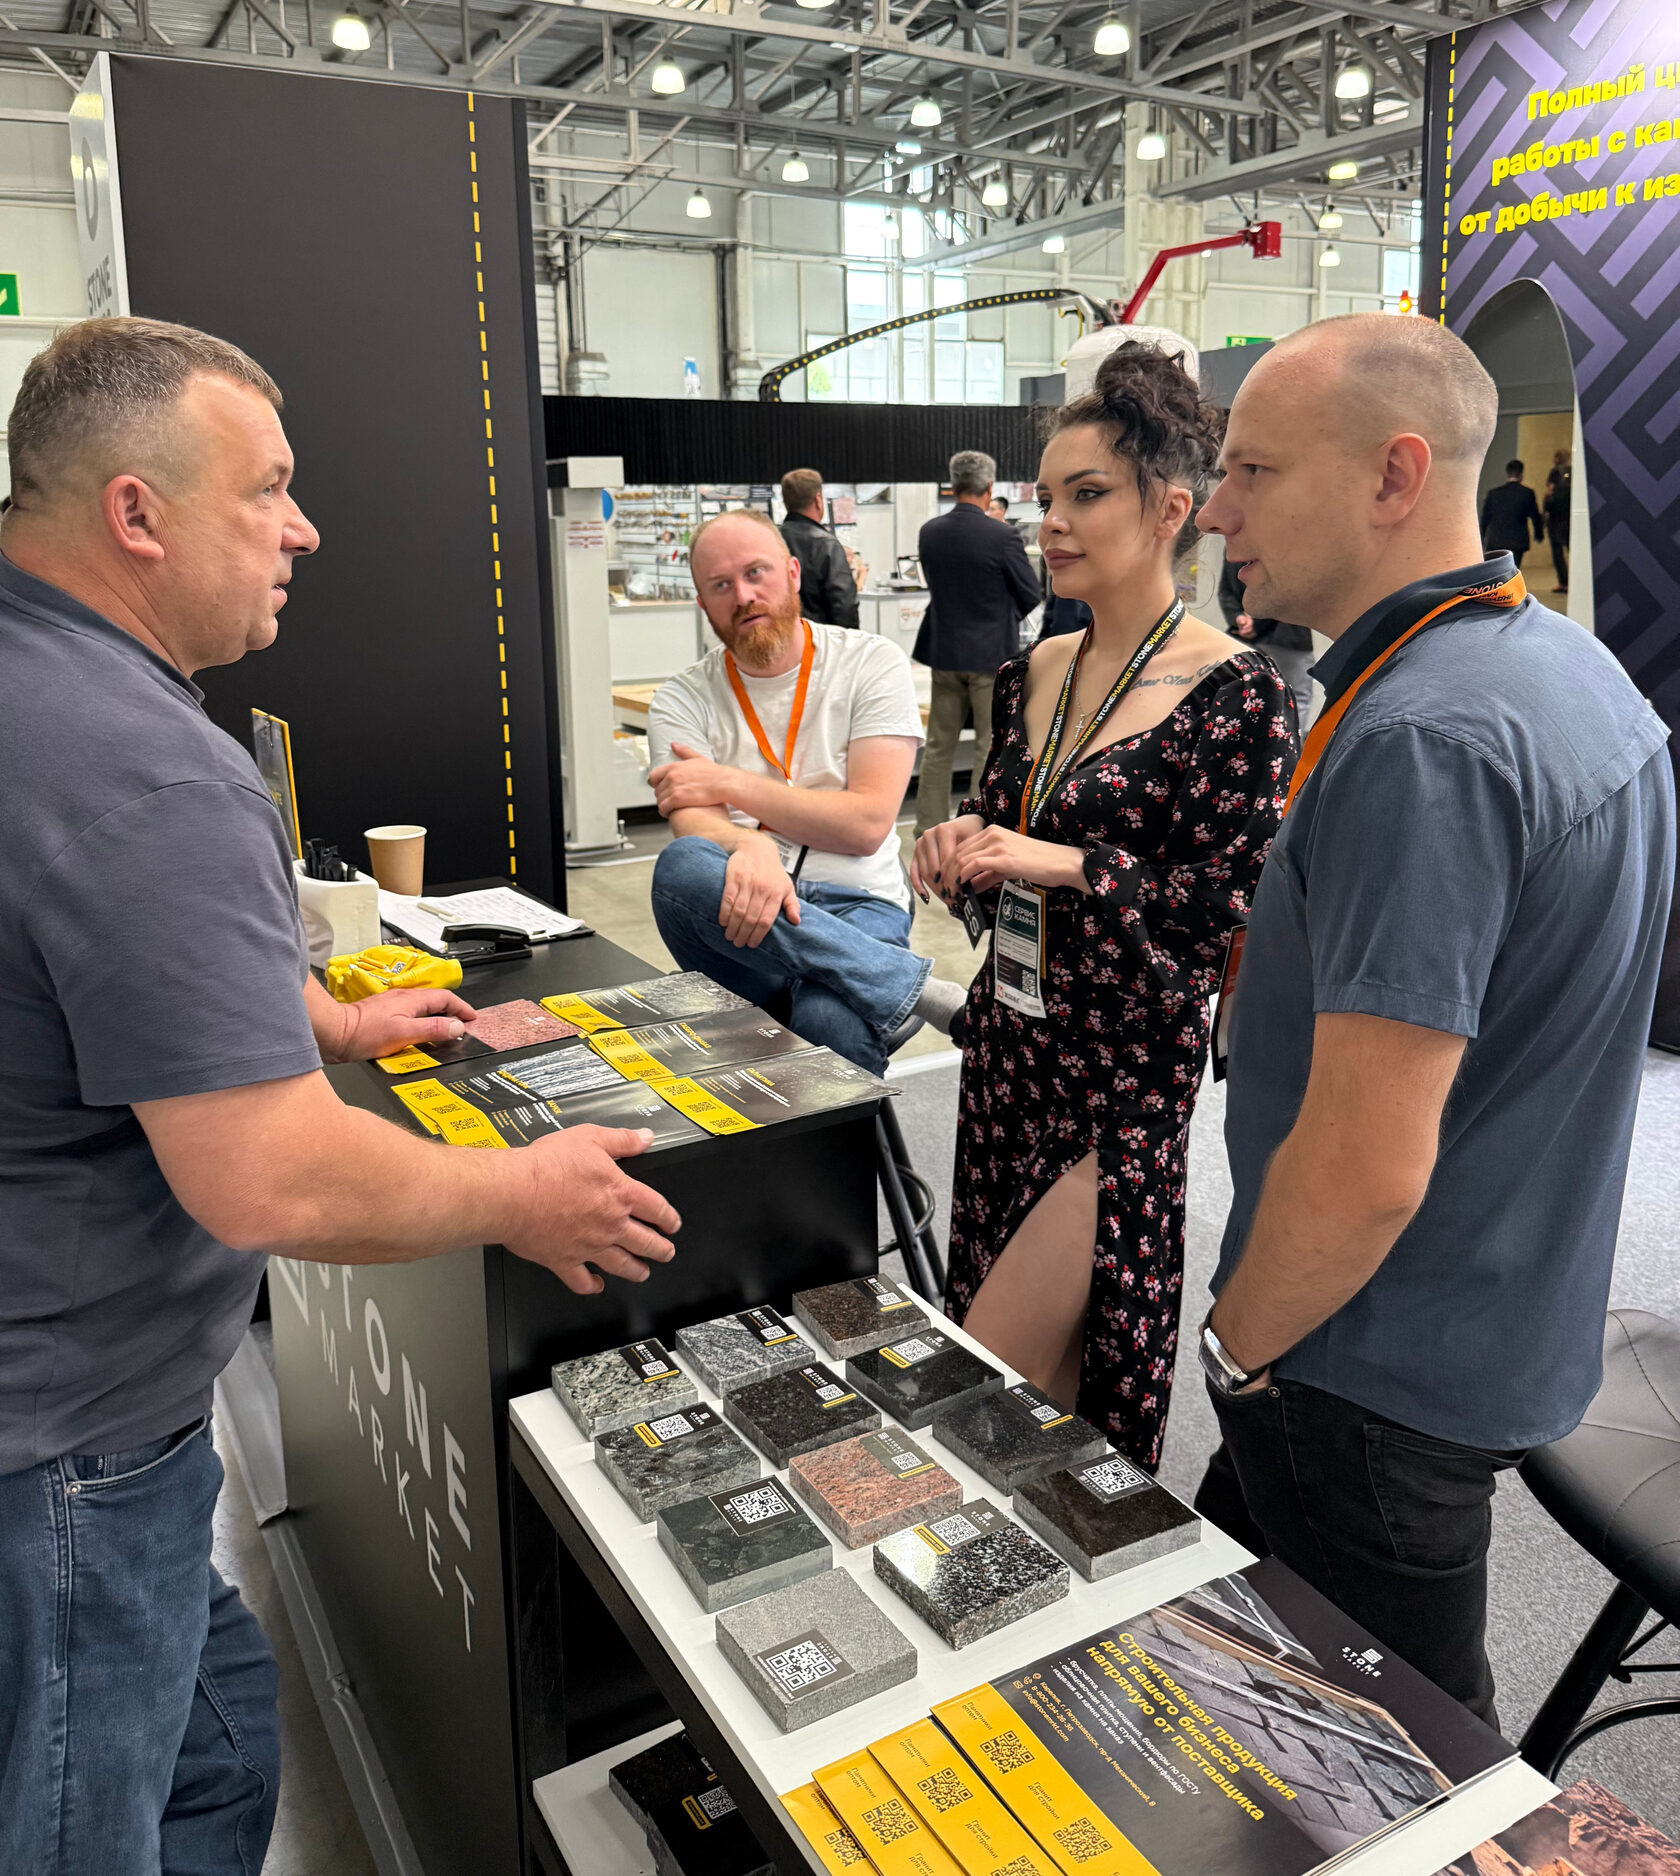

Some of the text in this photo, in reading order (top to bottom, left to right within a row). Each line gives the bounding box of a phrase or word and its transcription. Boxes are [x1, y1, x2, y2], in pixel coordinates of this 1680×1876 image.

[1527, 62, 1646, 120] Полный
[1491, 136, 1599, 186] работы
[1608, 130, 1627, 154] с
[1459, 210, 1491, 236] от
[1495, 186, 1608, 234] добычи
[1615, 182, 1636, 207] к
[87, 255, 112, 316] STONE
[320, 1308, 476, 1652] MARKET
[1341, 1646, 1381, 1677] STONE
[1052, 1668, 1124, 1745] изделия из камня на заказ
[1061, 1664, 1100, 1705] облицовочная
[1119, 1726, 1144, 1753] ступени
[1147, 1756, 1186, 1794] вентфасады
[1070, 1660, 1200, 1795] брусчатка, плиты мощения, бордюры по ГОСТУ
[1086, 1646, 1265, 1822] напрямую от поставщика
[1099, 1640, 1240, 1775] для вашего бизнеса
[1119, 1632, 1298, 1801] Строительная продукция
[846, 1770, 862, 1788] оптом
[899, 1741, 915, 1758] оптом
[972, 1819, 992, 1841] Гранит
[975, 1834, 999, 1859] стройки
